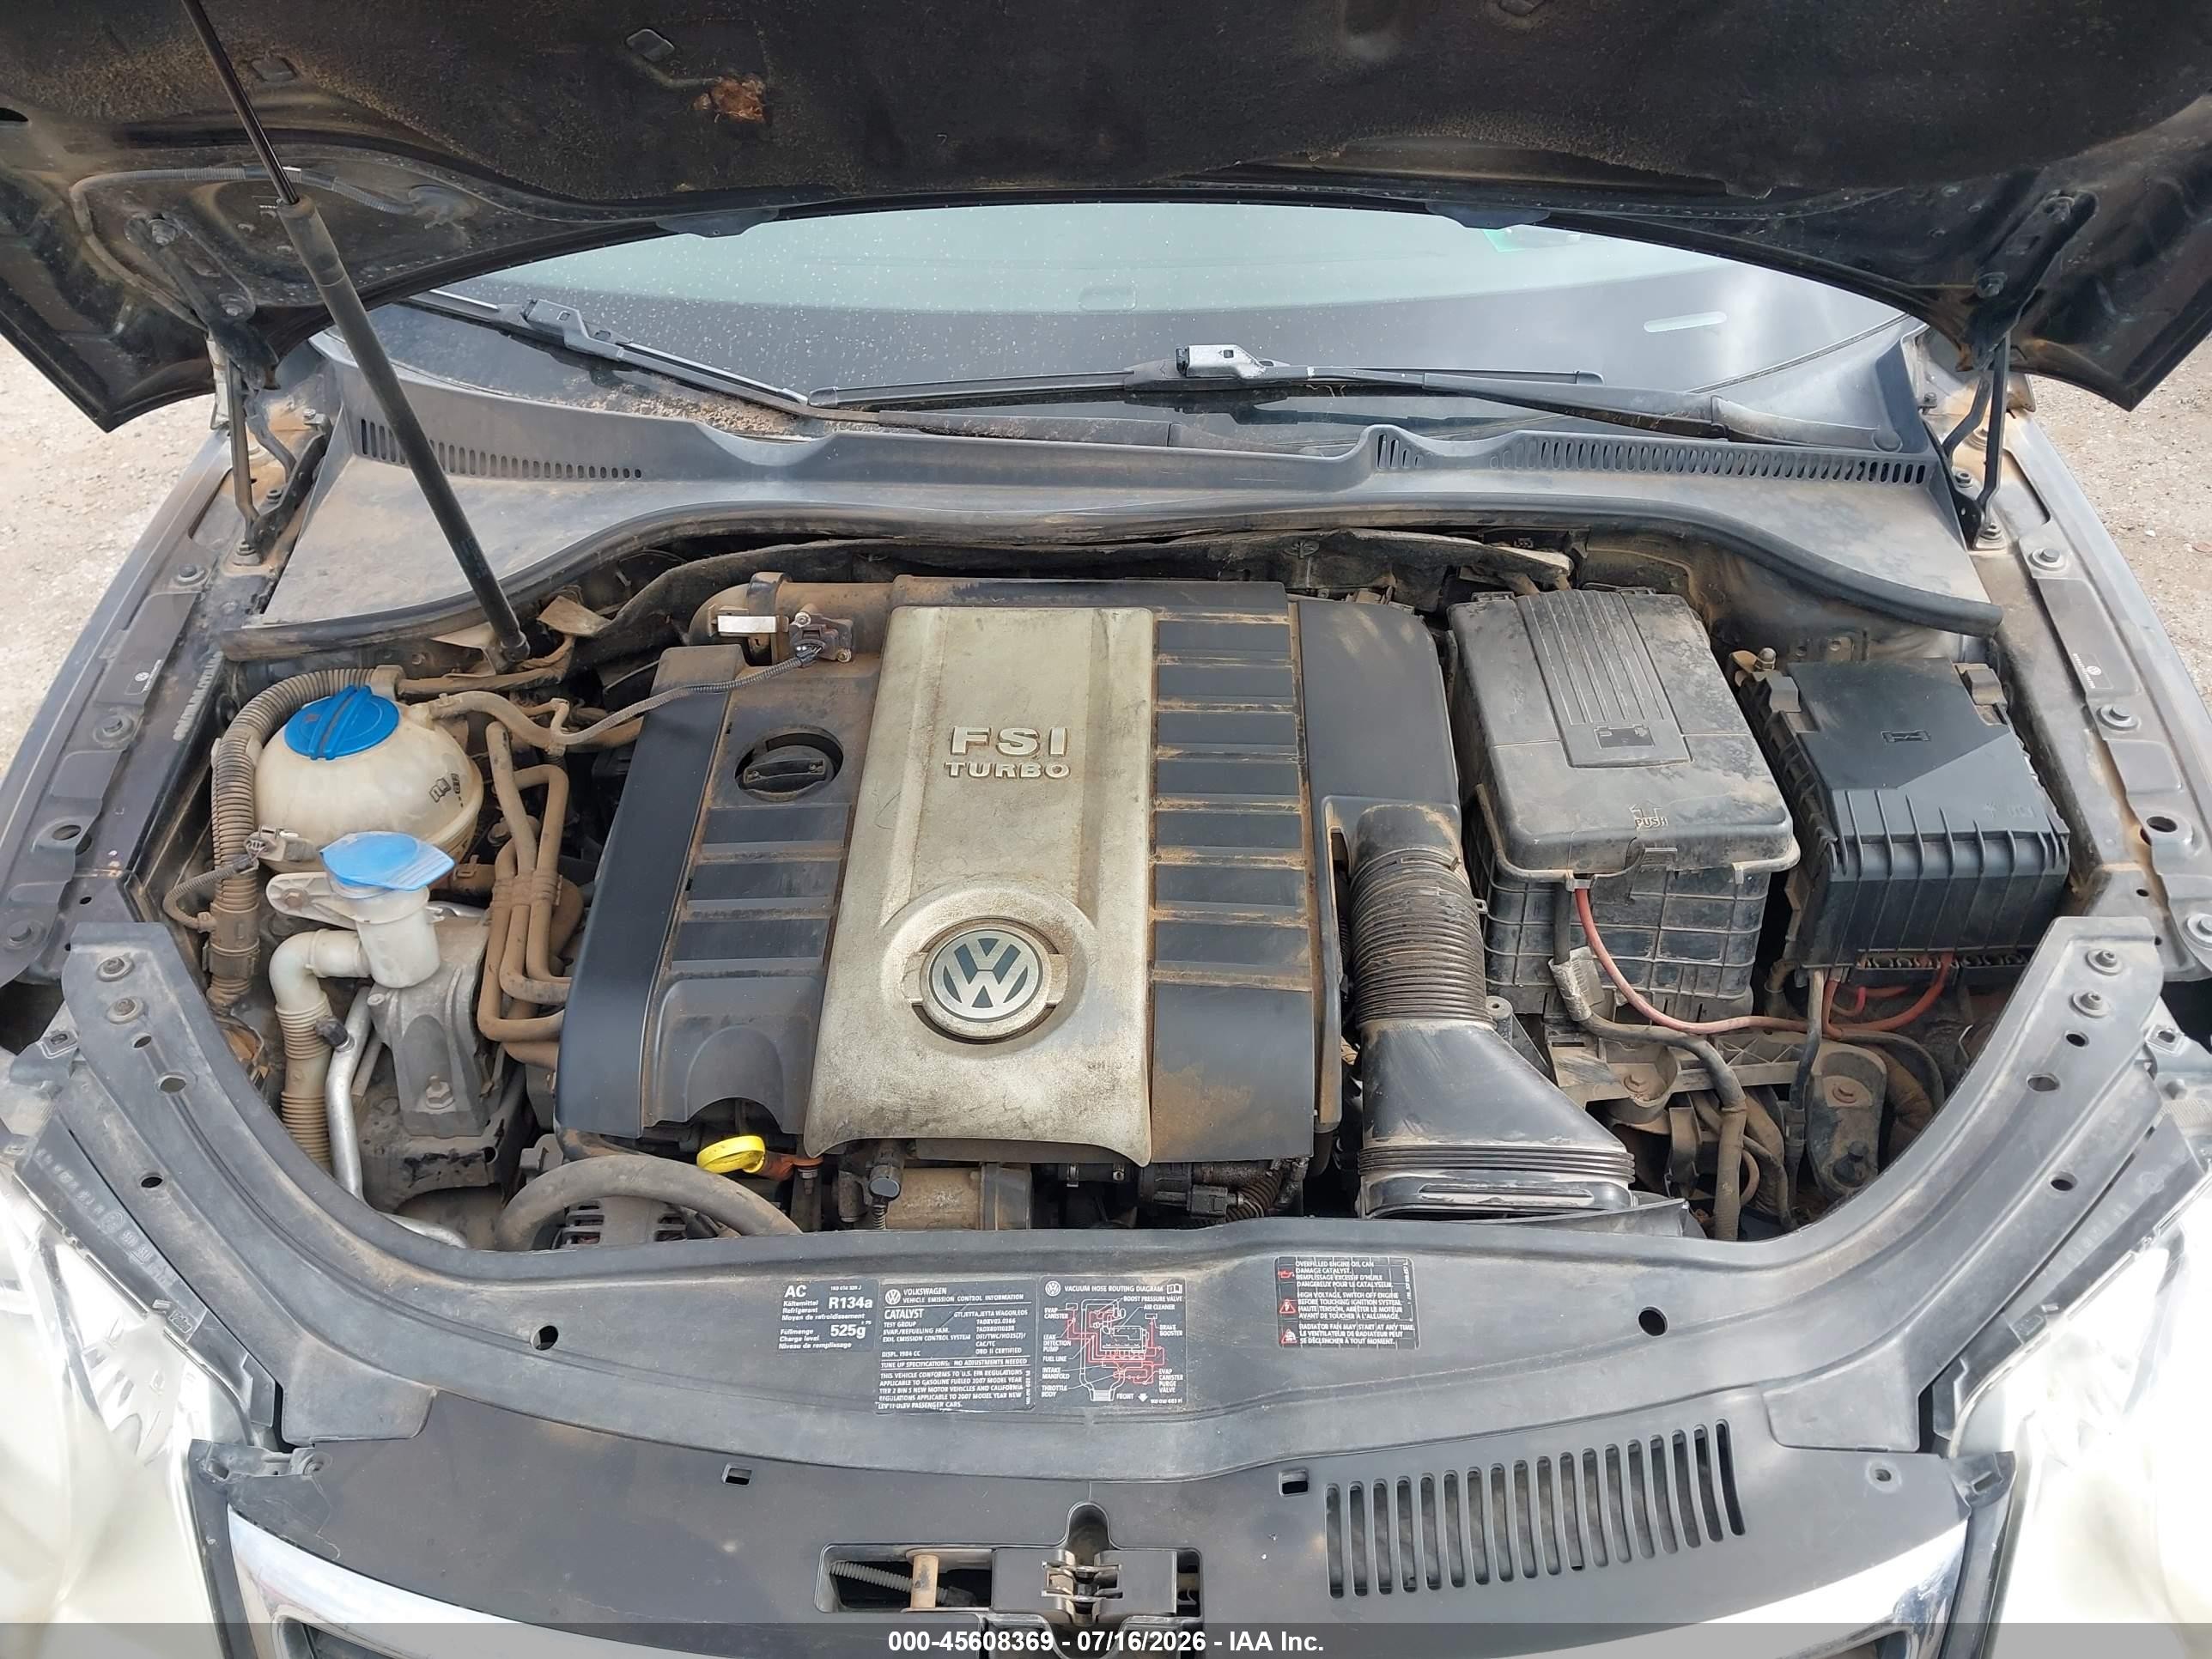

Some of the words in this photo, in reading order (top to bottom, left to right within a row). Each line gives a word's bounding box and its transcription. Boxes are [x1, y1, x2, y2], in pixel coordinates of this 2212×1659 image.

[950, 726, 1067, 757] FSI
[944, 761, 1071, 779] TURBO
[1634, 817, 1668, 829] PUSH
[784, 1285, 807, 1298] AC
[829, 1296, 873, 1309] R134a
[884, 1308, 924, 1319] CATALYST
[830, 1324, 866, 1340] 525g
